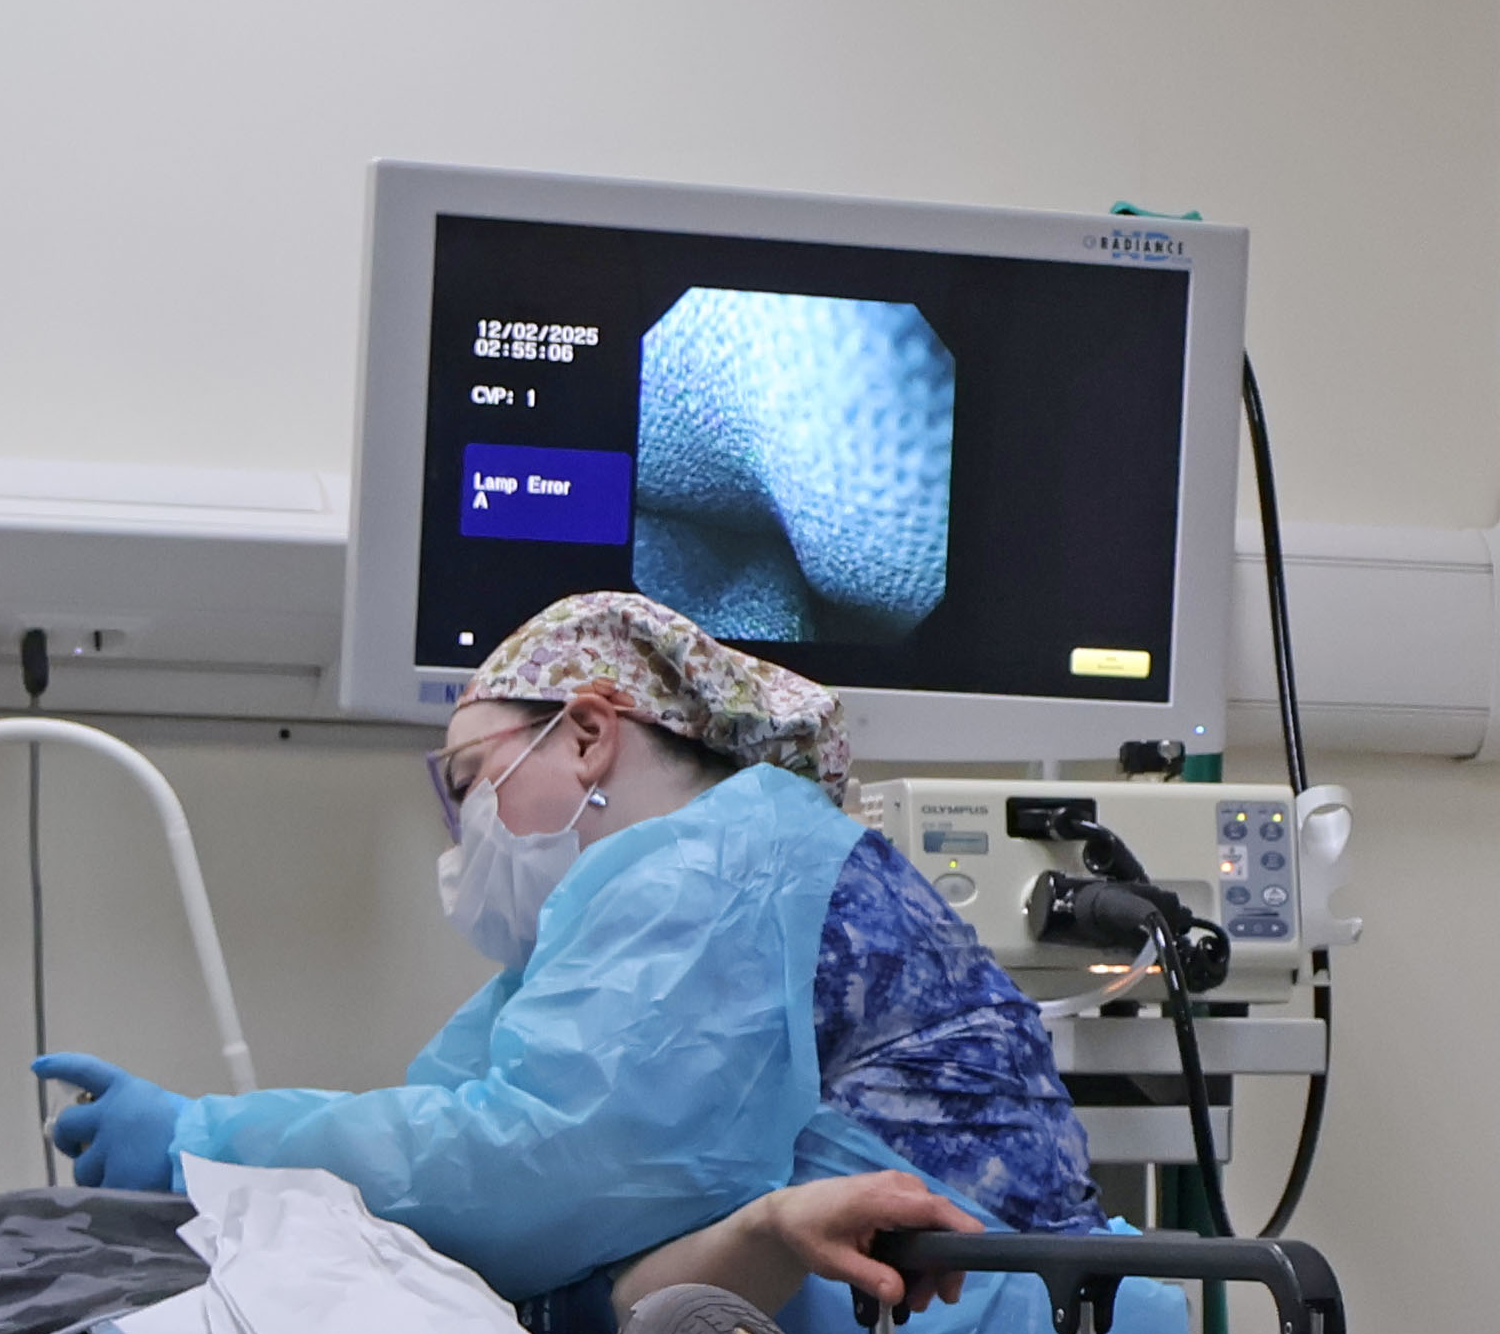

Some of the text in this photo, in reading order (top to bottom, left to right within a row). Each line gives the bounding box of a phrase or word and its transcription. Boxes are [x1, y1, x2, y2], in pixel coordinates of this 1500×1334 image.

[1100, 236, 1184, 255] RADIANCE
[477, 319, 599, 346] 12/02/2025
[474, 338, 574, 363] 02:55:06
[470, 385, 536, 408] CVP: 1
[473, 471, 571, 496] Lamp Error
[472, 490, 489, 510] A
[921, 804, 989, 815] OLYMPUS
